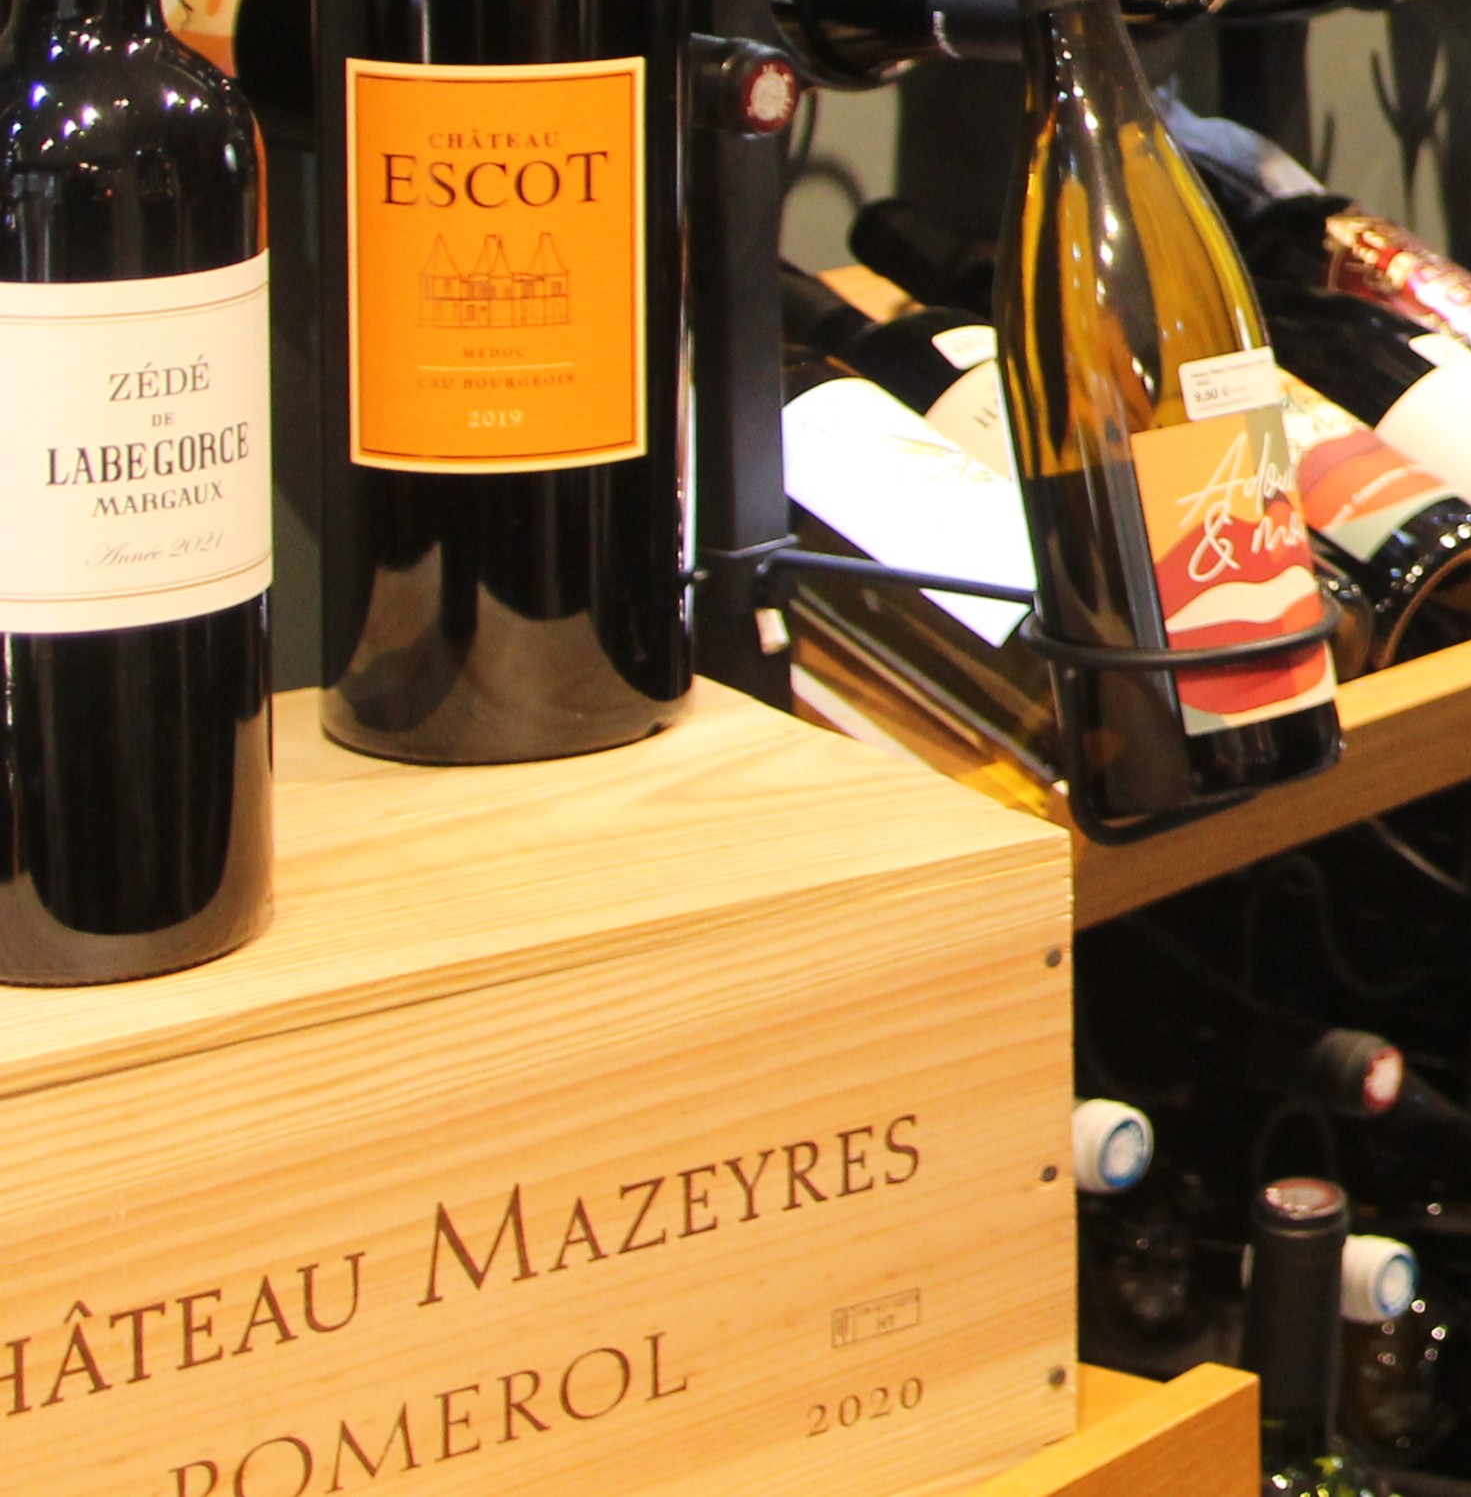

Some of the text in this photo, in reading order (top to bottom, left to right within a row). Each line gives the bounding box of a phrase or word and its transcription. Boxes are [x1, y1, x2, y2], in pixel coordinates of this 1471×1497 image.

[428, 128, 560, 150] CHÂTEAU
[381, 150, 608, 209] ESCOT
[108, 354, 211, 402] ZÉDÉ
[151, 412, 175, 427] DE
[467, 409, 525, 428] 2019
[45, 420, 249, 487] LABEGORCE
[92, 480, 224, 518] MARGAUX
[84, 541, 163, 568] Année
[1188, 501, 1241, 583] &
[0, 1113, 921, 1417] HÂTEAU MAZEYRES
[806, 1377, 924, 1437] 2020
